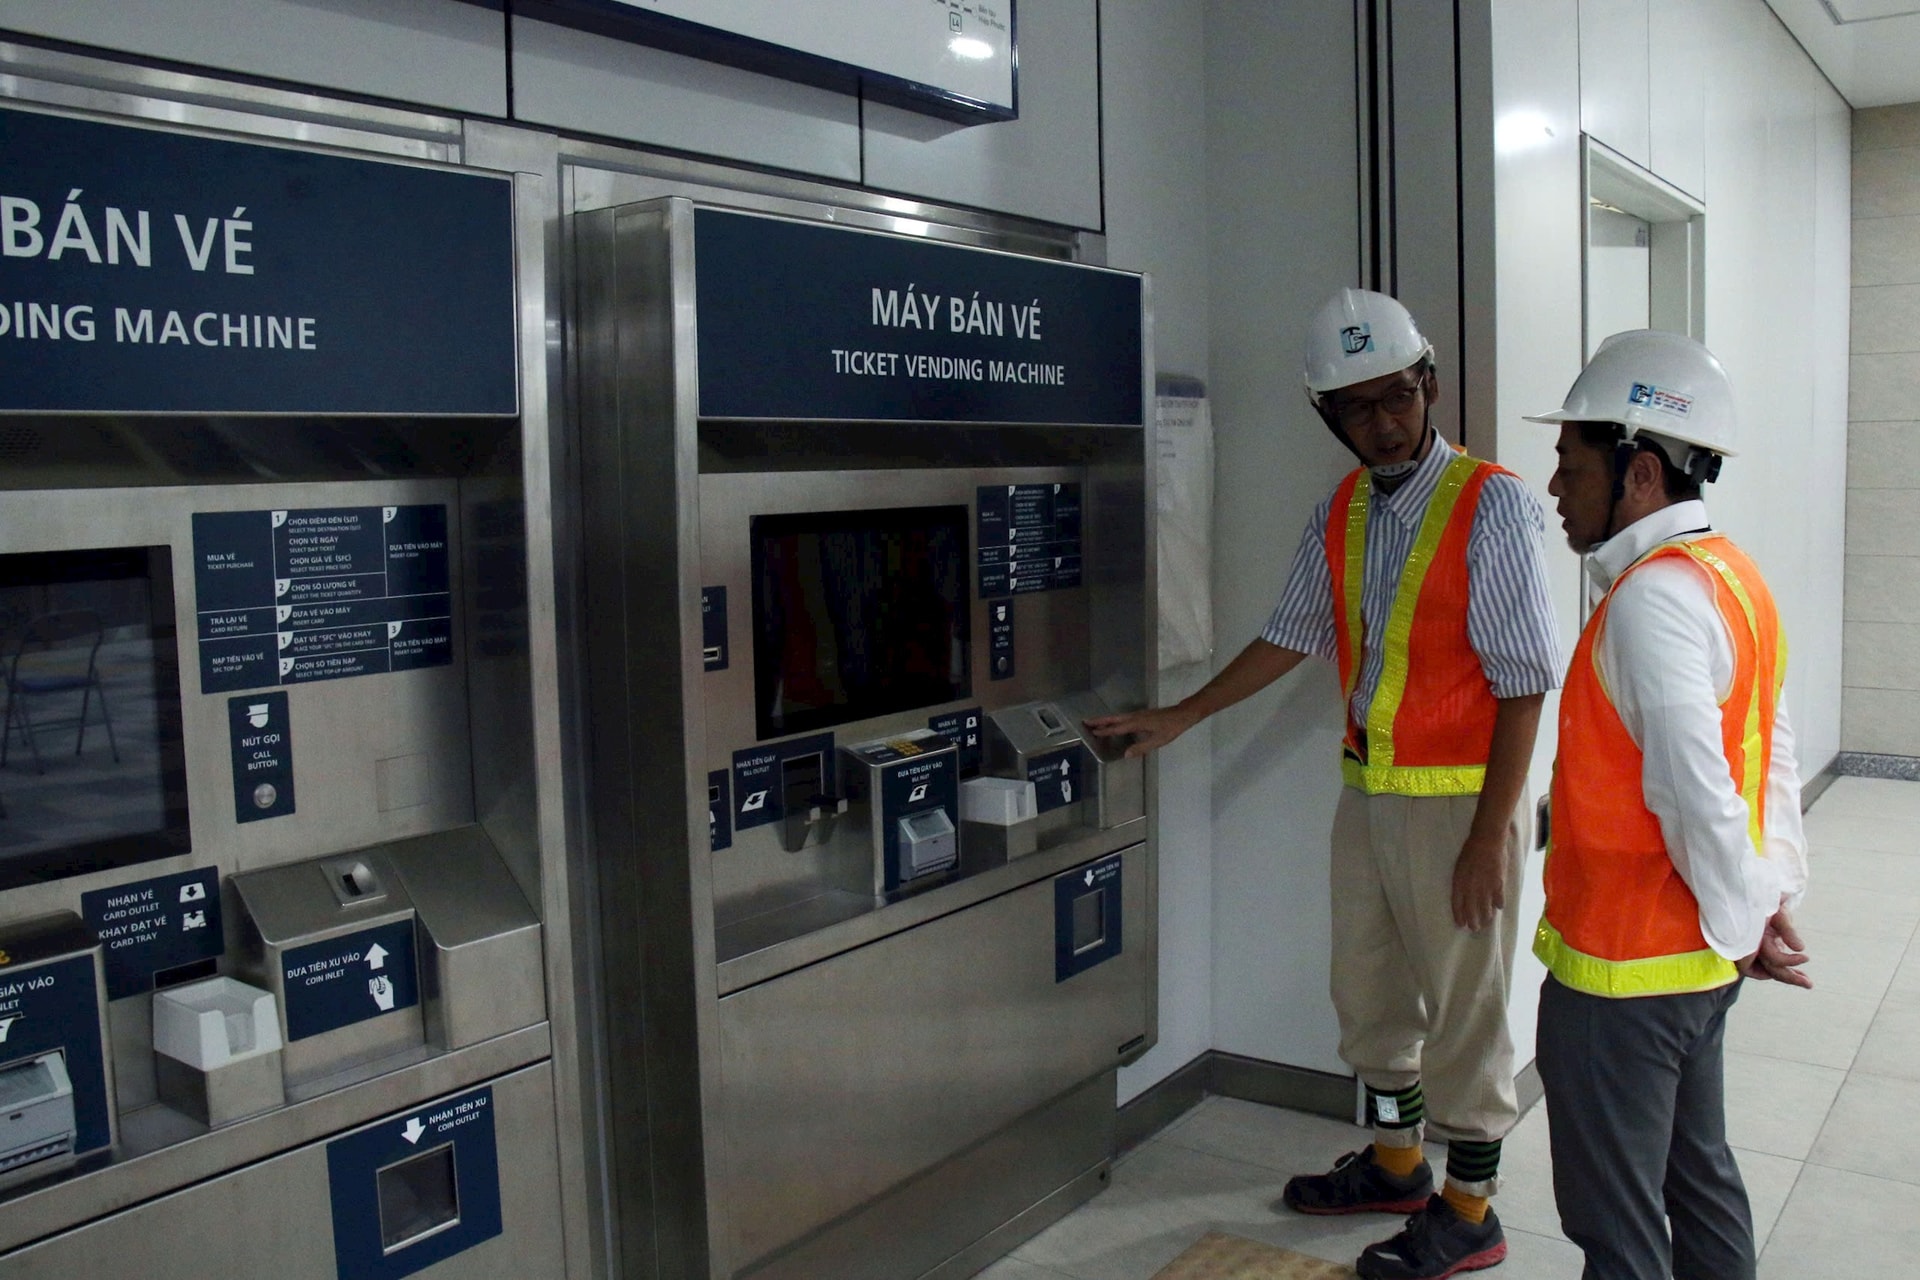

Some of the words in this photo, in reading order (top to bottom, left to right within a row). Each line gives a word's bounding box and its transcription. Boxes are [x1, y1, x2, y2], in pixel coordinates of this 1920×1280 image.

[952, 18, 959, 27] L4
[0, 188, 151, 267] BÁN
[174, 206, 254, 275] VÉ
[872, 283, 940, 330] MÁY
[950, 291, 1003, 337] BÁN
[1011, 299, 1041, 340] VÉ
[115, 307, 316, 350] MACHINE
[832, 350, 899, 376] TICKET
[905, 354, 983, 381] VENDING
[989, 361, 1064, 385] MACHINE
[226, 552, 235, 560] VÉ
[238, 615, 247, 623] VÉ
[242, 736, 262, 747] NÚT
[264, 734, 280, 744] GỌI
[253, 750, 271, 759] CALL
[248, 760, 278, 770] BUTTON
[108, 894, 138, 908] NHẬN
[141, 888, 153, 900] VÉ
[103, 910, 126, 921] CARD
[129, 902, 160, 915] OUTLET
[98, 925, 128, 940] KHAY
[154, 915, 167, 926] VÉ
[111, 938, 134, 949] CARD
[136, 932, 158, 943] TRAY
[287, 967, 307, 979] ĐƯA
[308, 961, 327, 973] TIỀN
[329, 957, 341, 968] XU
[342, 952, 360, 964] VÀO
[28, 976, 55, 990] VÀO
[305, 976, 324, 986] COIN
[325, 969, 345, 980] INLET
[429, 1110, 454, 1125] NHẬN
[455, 1102, 474, 1114] TIỀN
[475, 1097, 486, 1108] XU
[438, 1120, 455, 1132] COIN
[456, 1111, 480, 1126] OUTLET
